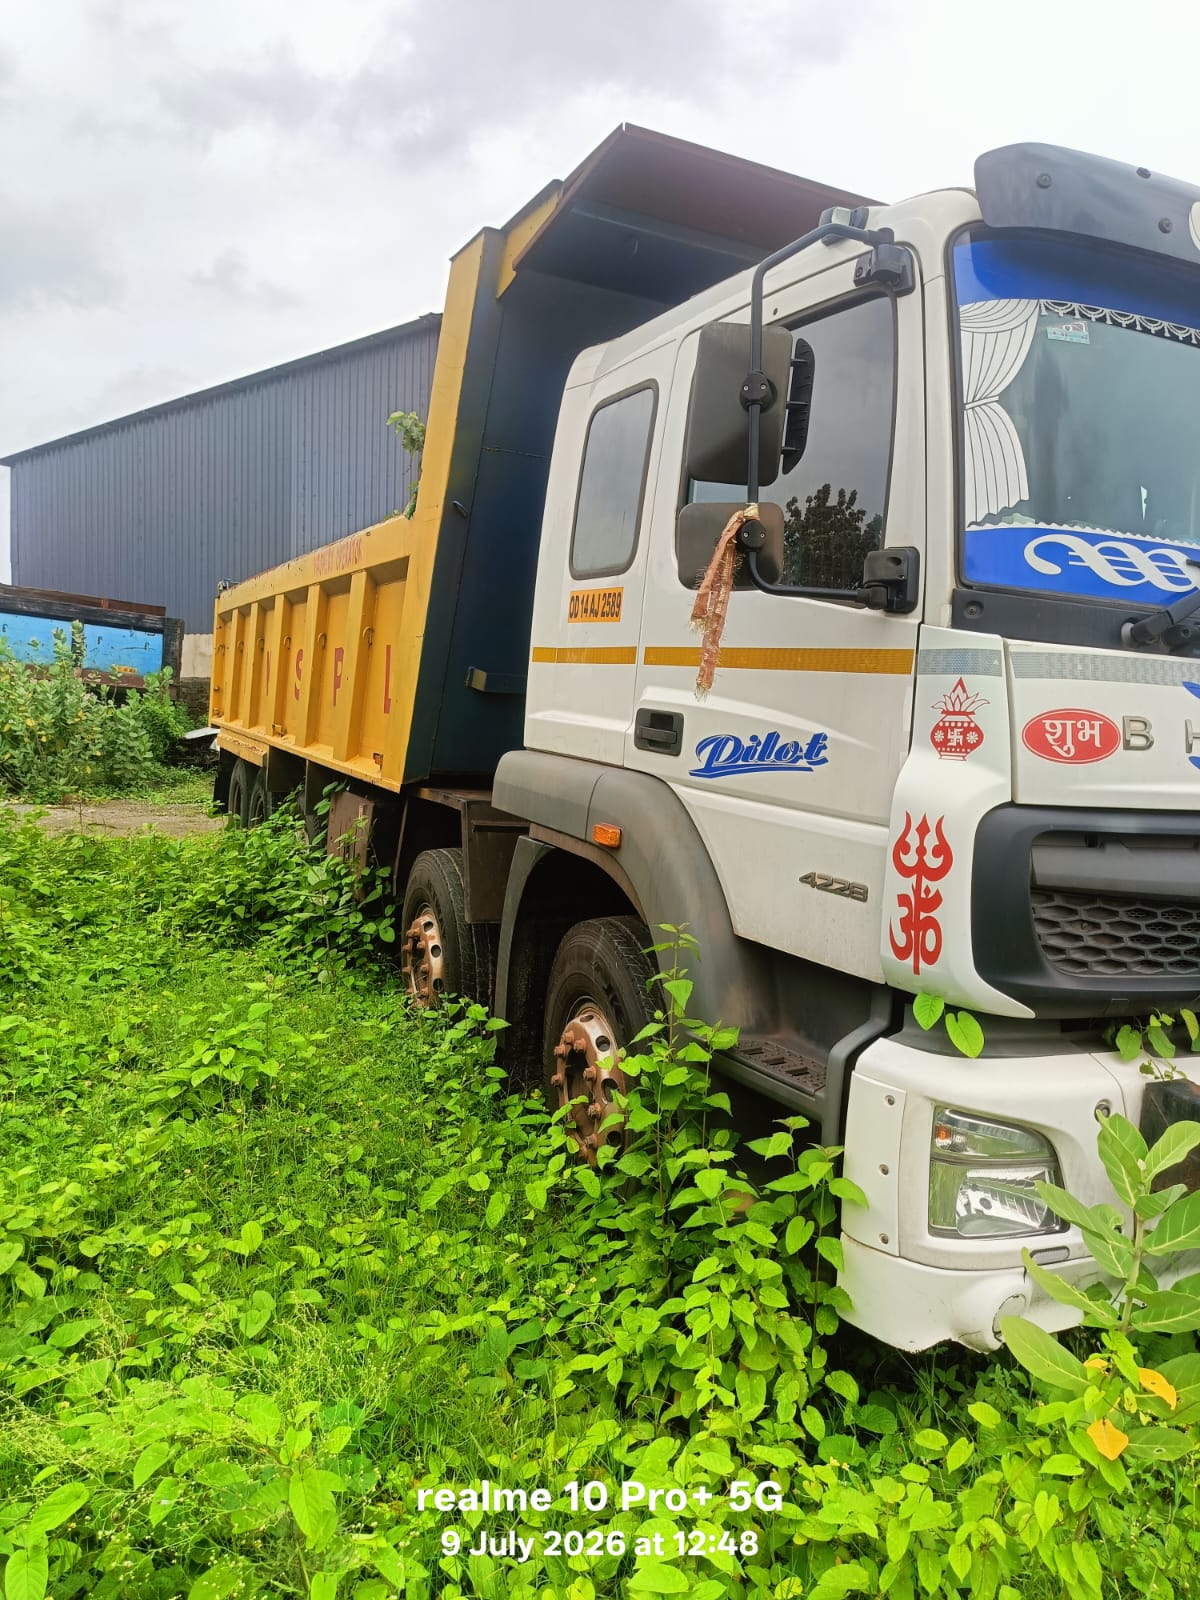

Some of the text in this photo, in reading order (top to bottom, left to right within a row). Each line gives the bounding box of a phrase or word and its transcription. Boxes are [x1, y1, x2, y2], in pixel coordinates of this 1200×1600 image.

[688, 731, 829, 778] Pilot
[1042, 718, 1104, 758] शुभ
[798, 871, 868, 902] 4228
